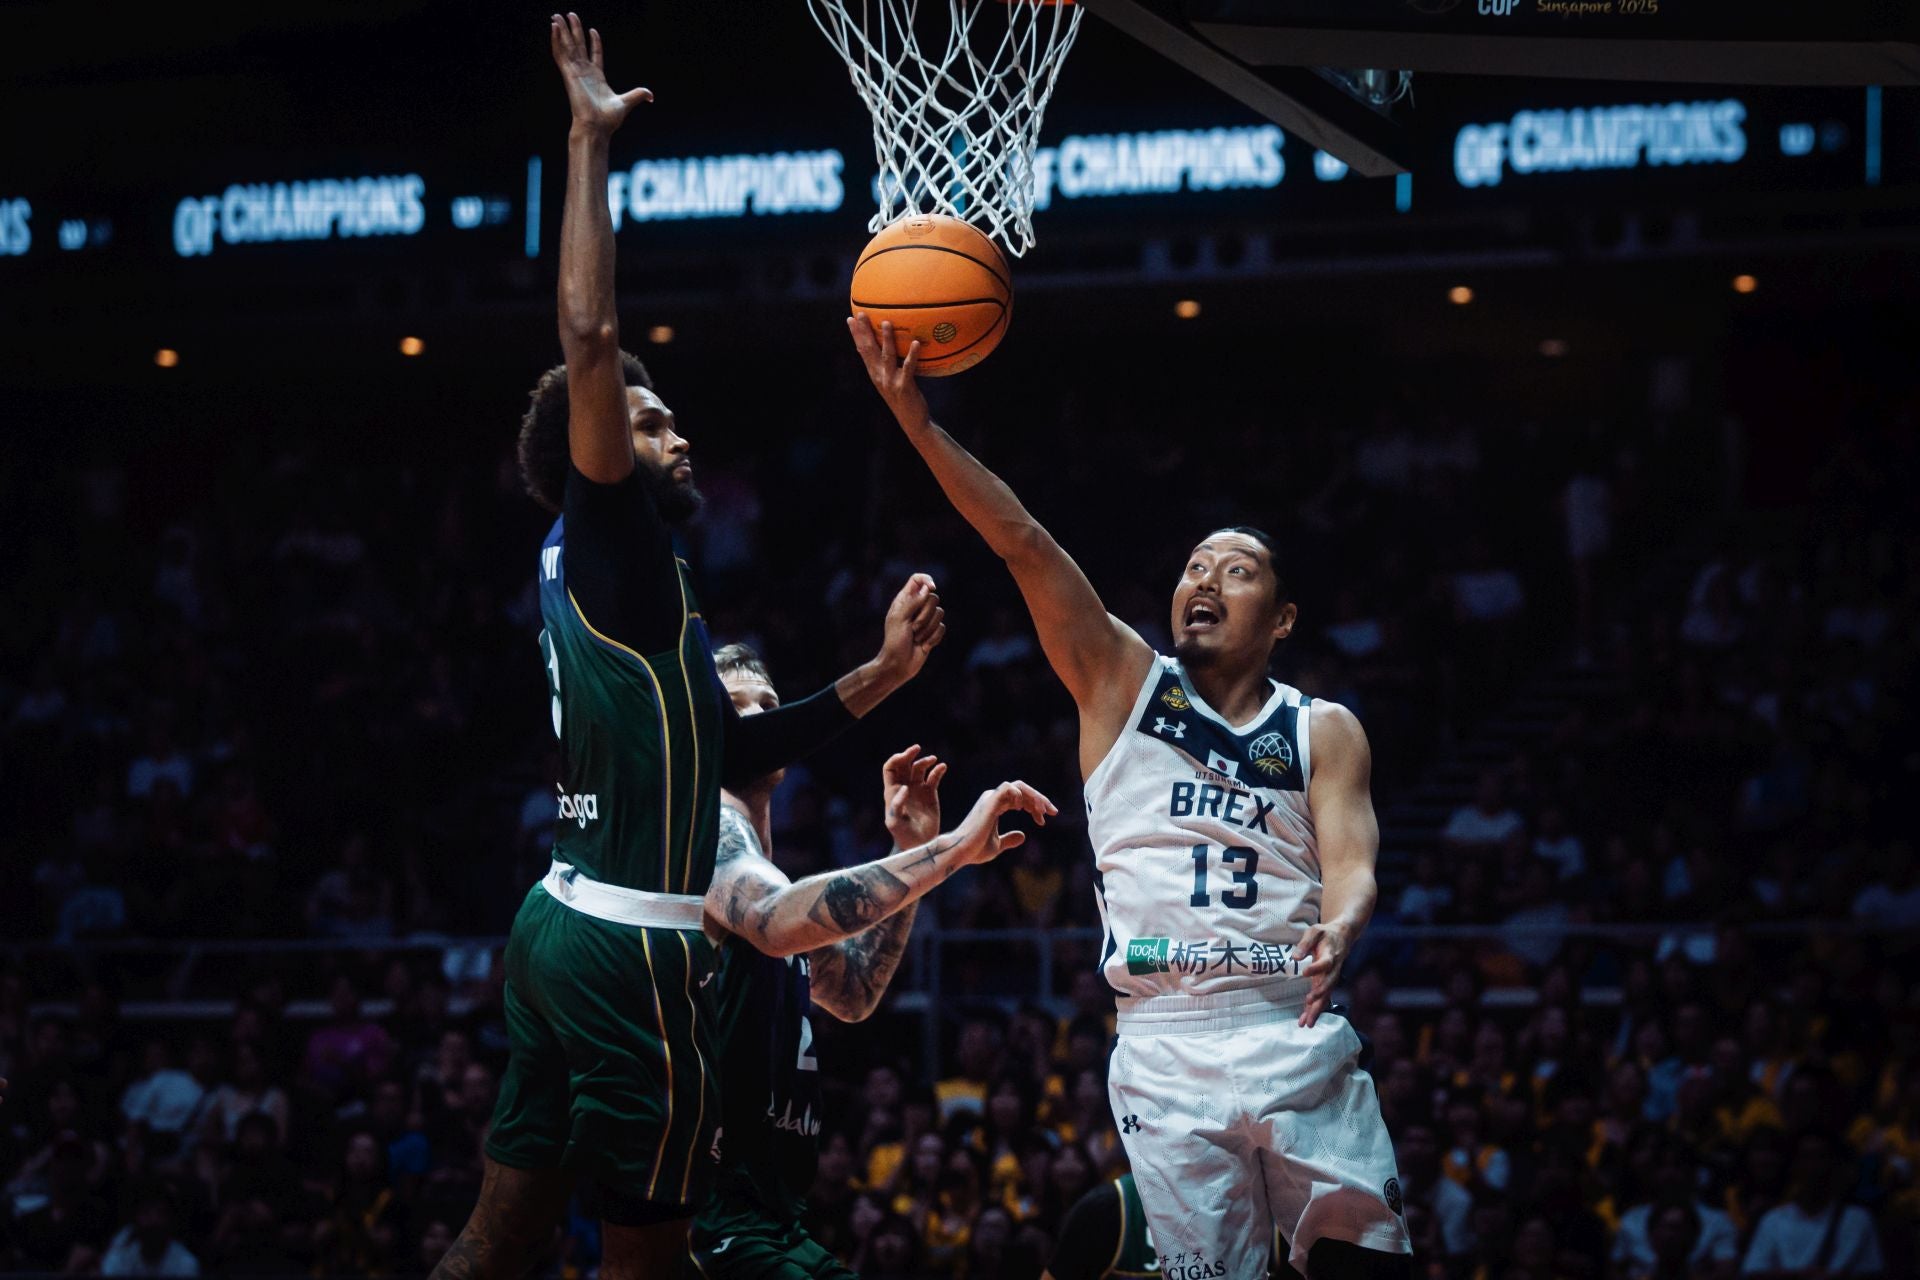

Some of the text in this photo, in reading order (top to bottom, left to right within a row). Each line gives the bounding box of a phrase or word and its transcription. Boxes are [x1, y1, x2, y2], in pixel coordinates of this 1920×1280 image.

[1477, 0, 1520, 16] CUP
[1536, 0, 1659, 20] Singapore 2025
[1059, 124, 1284, 199] CHAMPIONS
[1454, 123, 1507, 187] OF
[1509, 99, 1746, 173] CHAMPIONS
[173, 196, 220, 257] OF
[221, 173, 424, 243] CHAMPIONS
[608, 172, 630, 233] F
[630, 149, 844, 223] CHAMPIONS
[1170, 781, 1275, 834] BREX
[1190, 844, 1259, 909] 13
